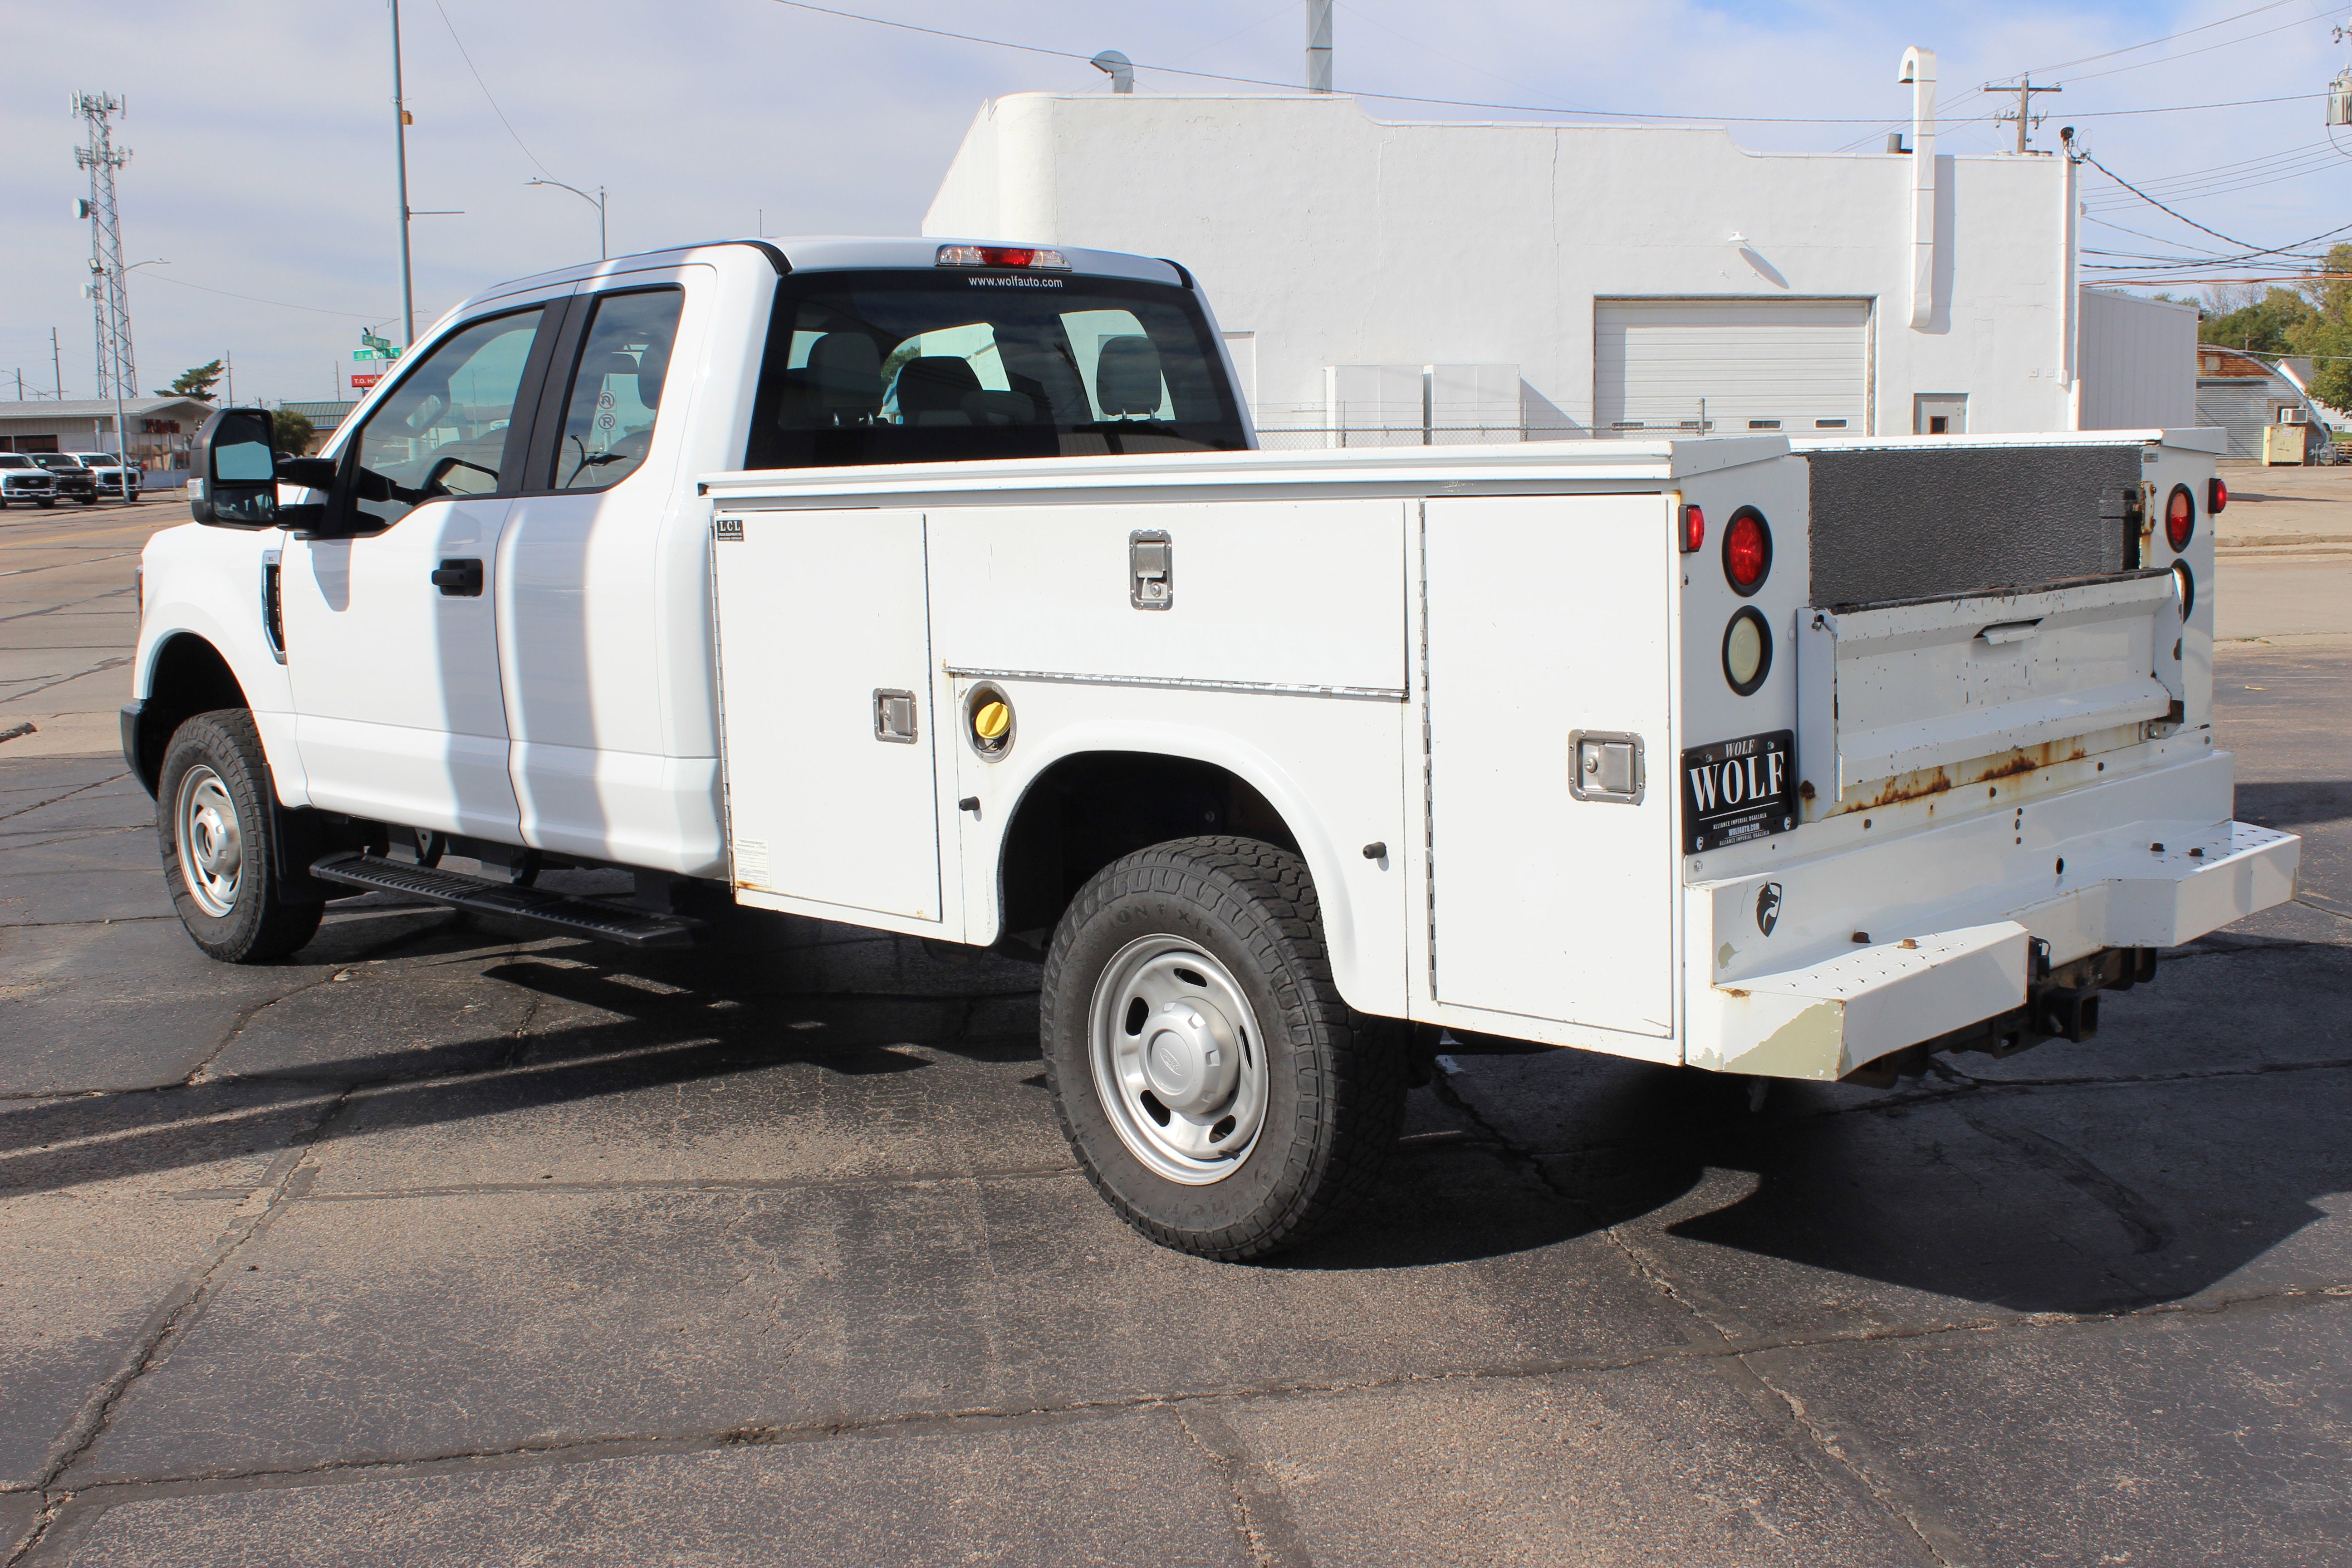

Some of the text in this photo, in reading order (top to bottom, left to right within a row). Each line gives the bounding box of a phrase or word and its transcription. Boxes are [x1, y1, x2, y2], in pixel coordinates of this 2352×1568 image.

[968, 275, 1063, 288] www.wolfauto.com
[719, 521, 740, 531] LCL
[1725, 739, 1755, 758] WOLF
[1689, 751, 1784, 811] WOLF
[1713, 813, 1767, 830] ALLIANCE IMPERIAL OGALLALA
[1728, 823, 1760, 836] WOLFAUTO.COM
[1720, 830, 1769, 846] ALLIANCE IMPERIAL OGALLALA
